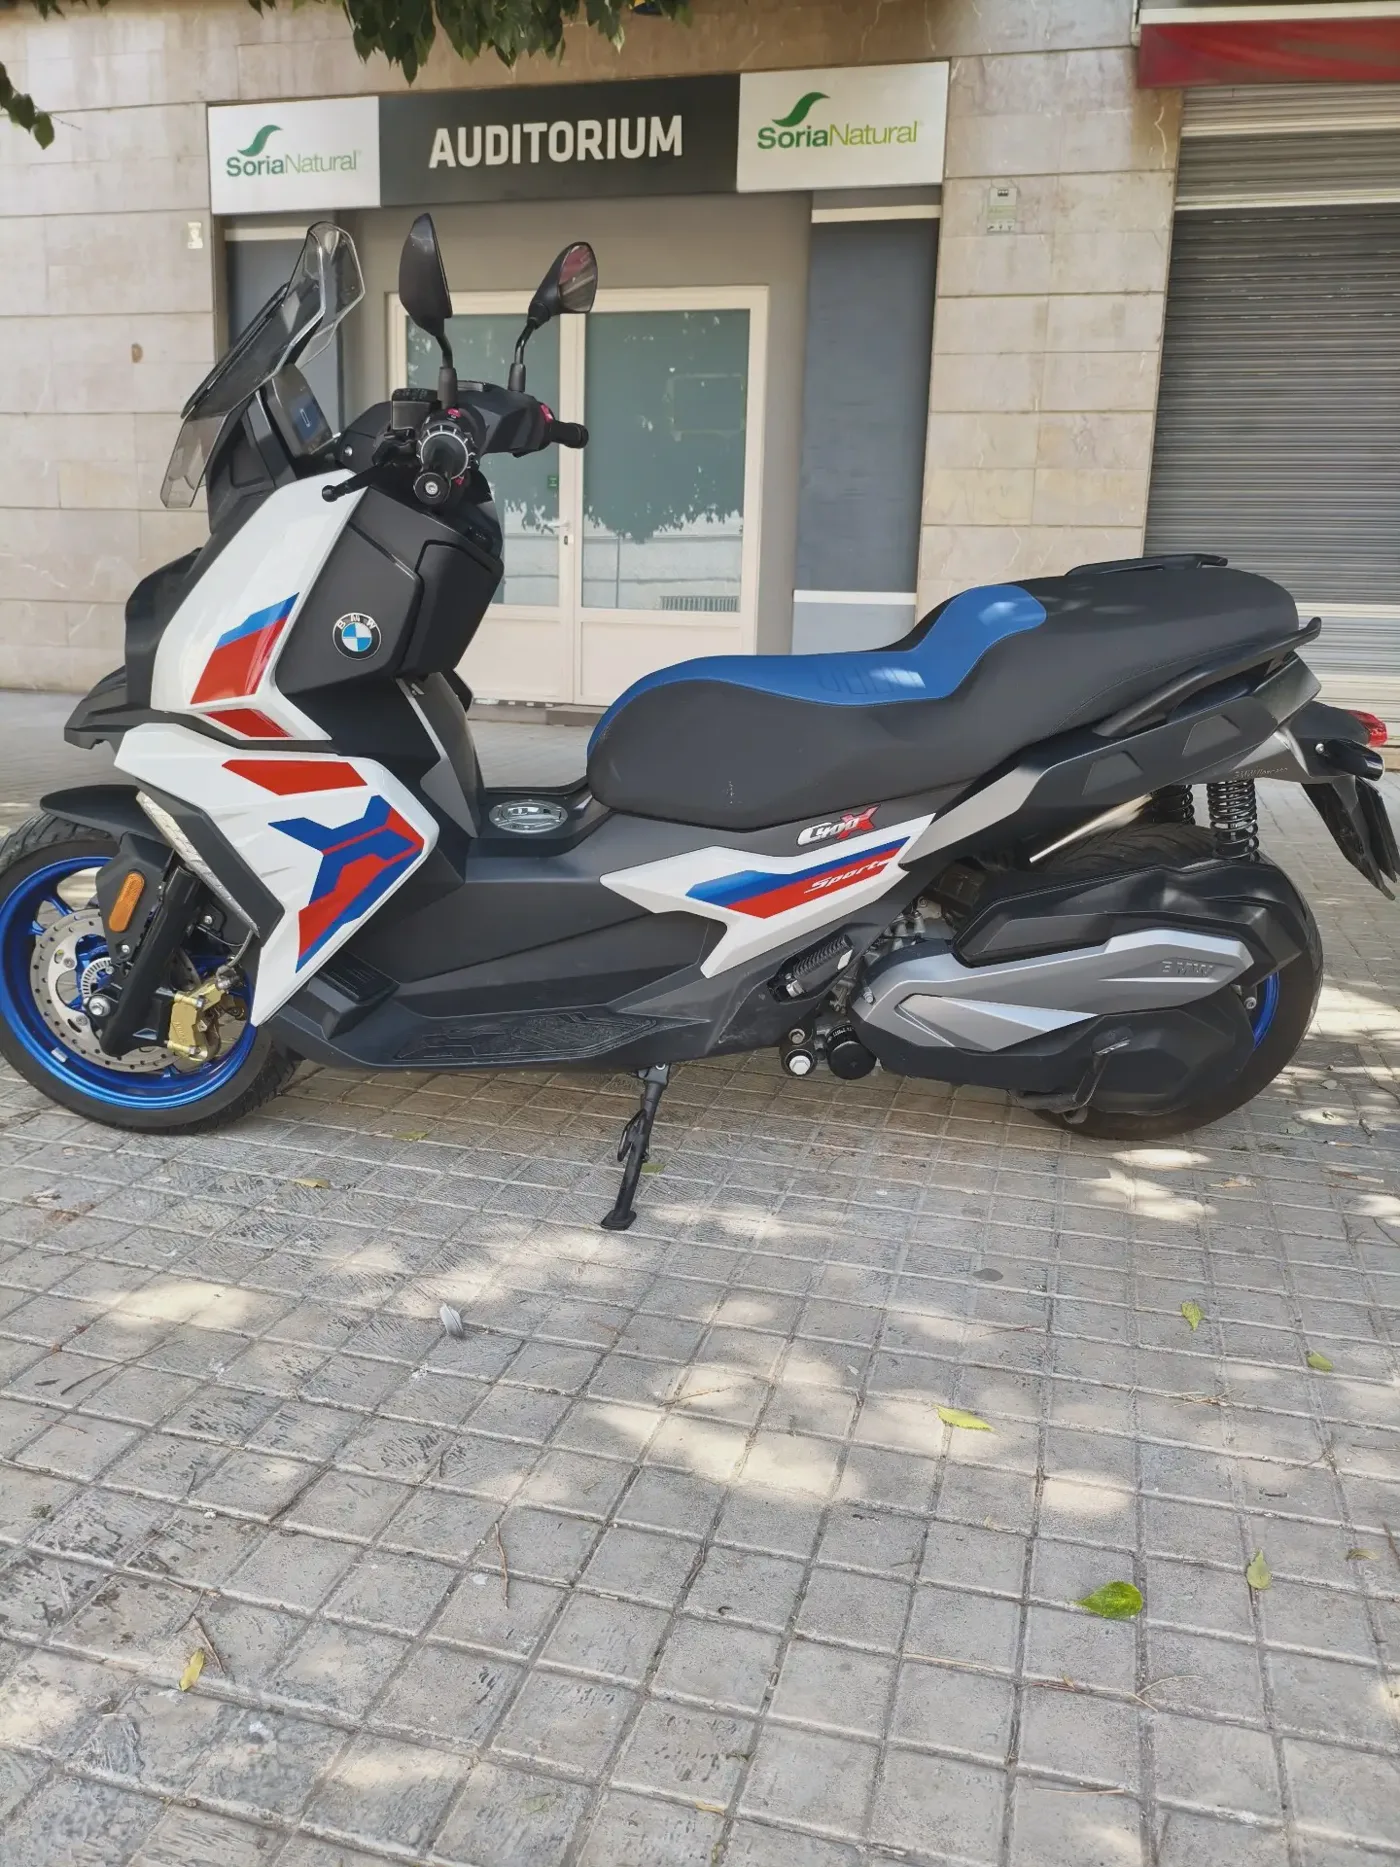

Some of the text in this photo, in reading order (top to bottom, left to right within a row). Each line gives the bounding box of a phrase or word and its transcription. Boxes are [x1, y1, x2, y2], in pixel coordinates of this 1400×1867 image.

[428, 114, 684, 169] AUDITORIUM
[757, 120, 919, 150] SoriaNatural
[225, 150, 358, 178] SoriaNatural
[336, 613, 377, 630] BMW
[803, 860, 890, 894] Sport
[1162, 961, 1213, 976] BMW
